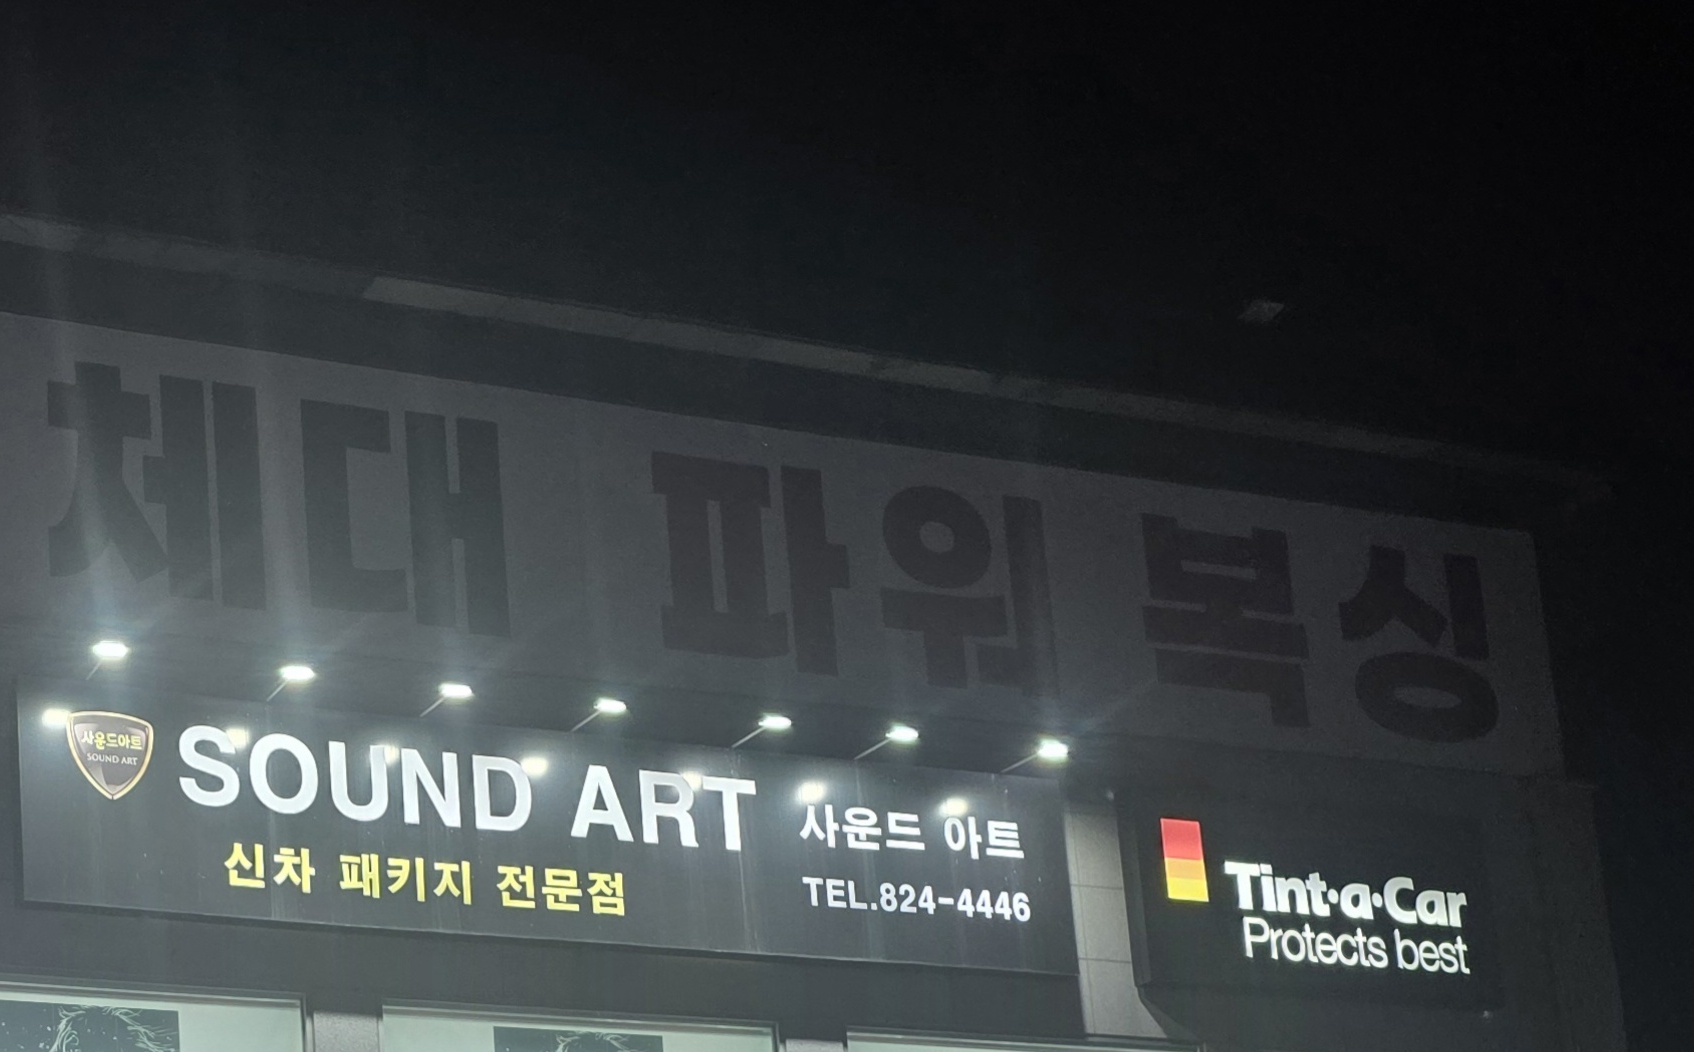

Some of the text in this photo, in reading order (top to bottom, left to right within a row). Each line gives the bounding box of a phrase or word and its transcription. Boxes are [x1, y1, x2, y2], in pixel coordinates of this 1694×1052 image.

[46, 360, 512, 640] 체대
[650, 450, 1060, 698] 파워
[1140, 511, 1500, 743] 복싱
[81, 729, 143, 751] 사운드아트
[87, 752, 139, 766] SOUND ART
[178, 724, 757, 852] SOUND ART
[799, 803, 1026, 861] 사운드 아트
[224, 842, 626, 917] 신차 패키지 전문점
[802, 876, 1031, 923] TEL.824-4446
[1242, 916, 1471, 974] Protects best
